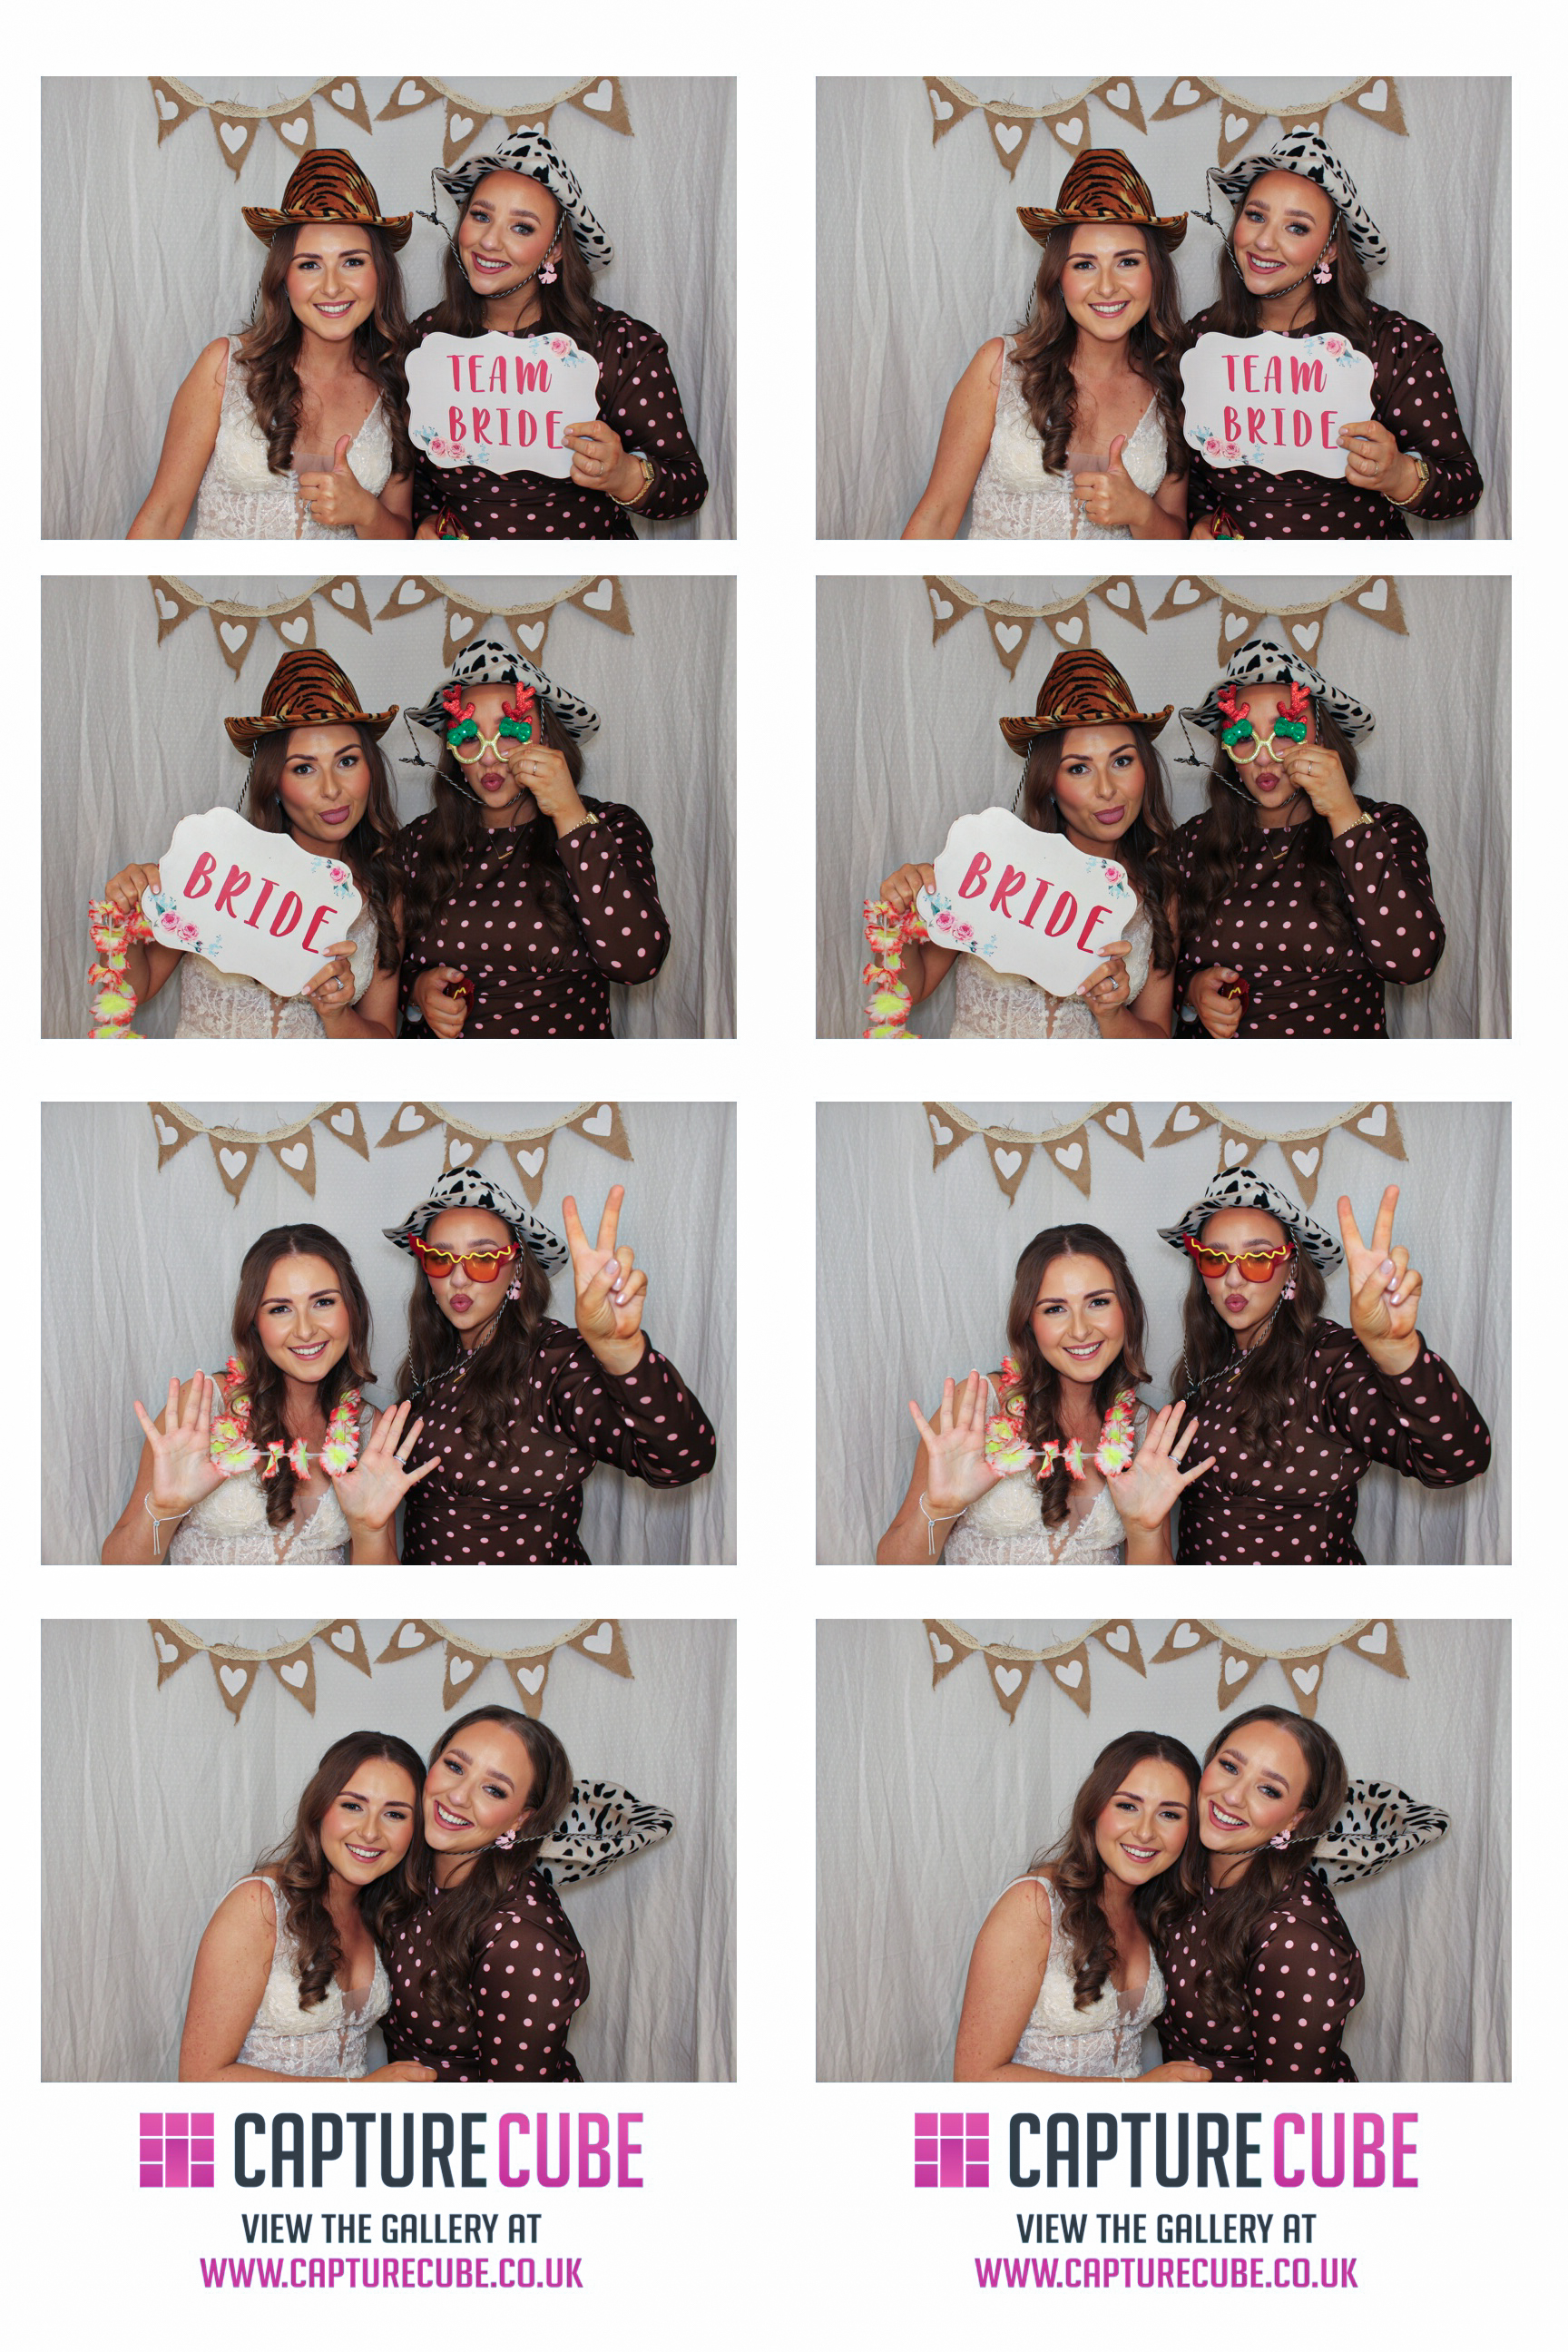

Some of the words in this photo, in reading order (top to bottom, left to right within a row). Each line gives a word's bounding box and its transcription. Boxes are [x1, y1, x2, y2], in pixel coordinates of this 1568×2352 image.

[446, 354, 553, 396] TEAM
[1221, 354, 1328, 396] TEAM
[448, 406, 564, 450] BRIDE
[1223, 406, 1338, 450] BRIDE
[182, 851, 338, 955] BRIDE
[957, 851, 1113, 955] BRIDE
